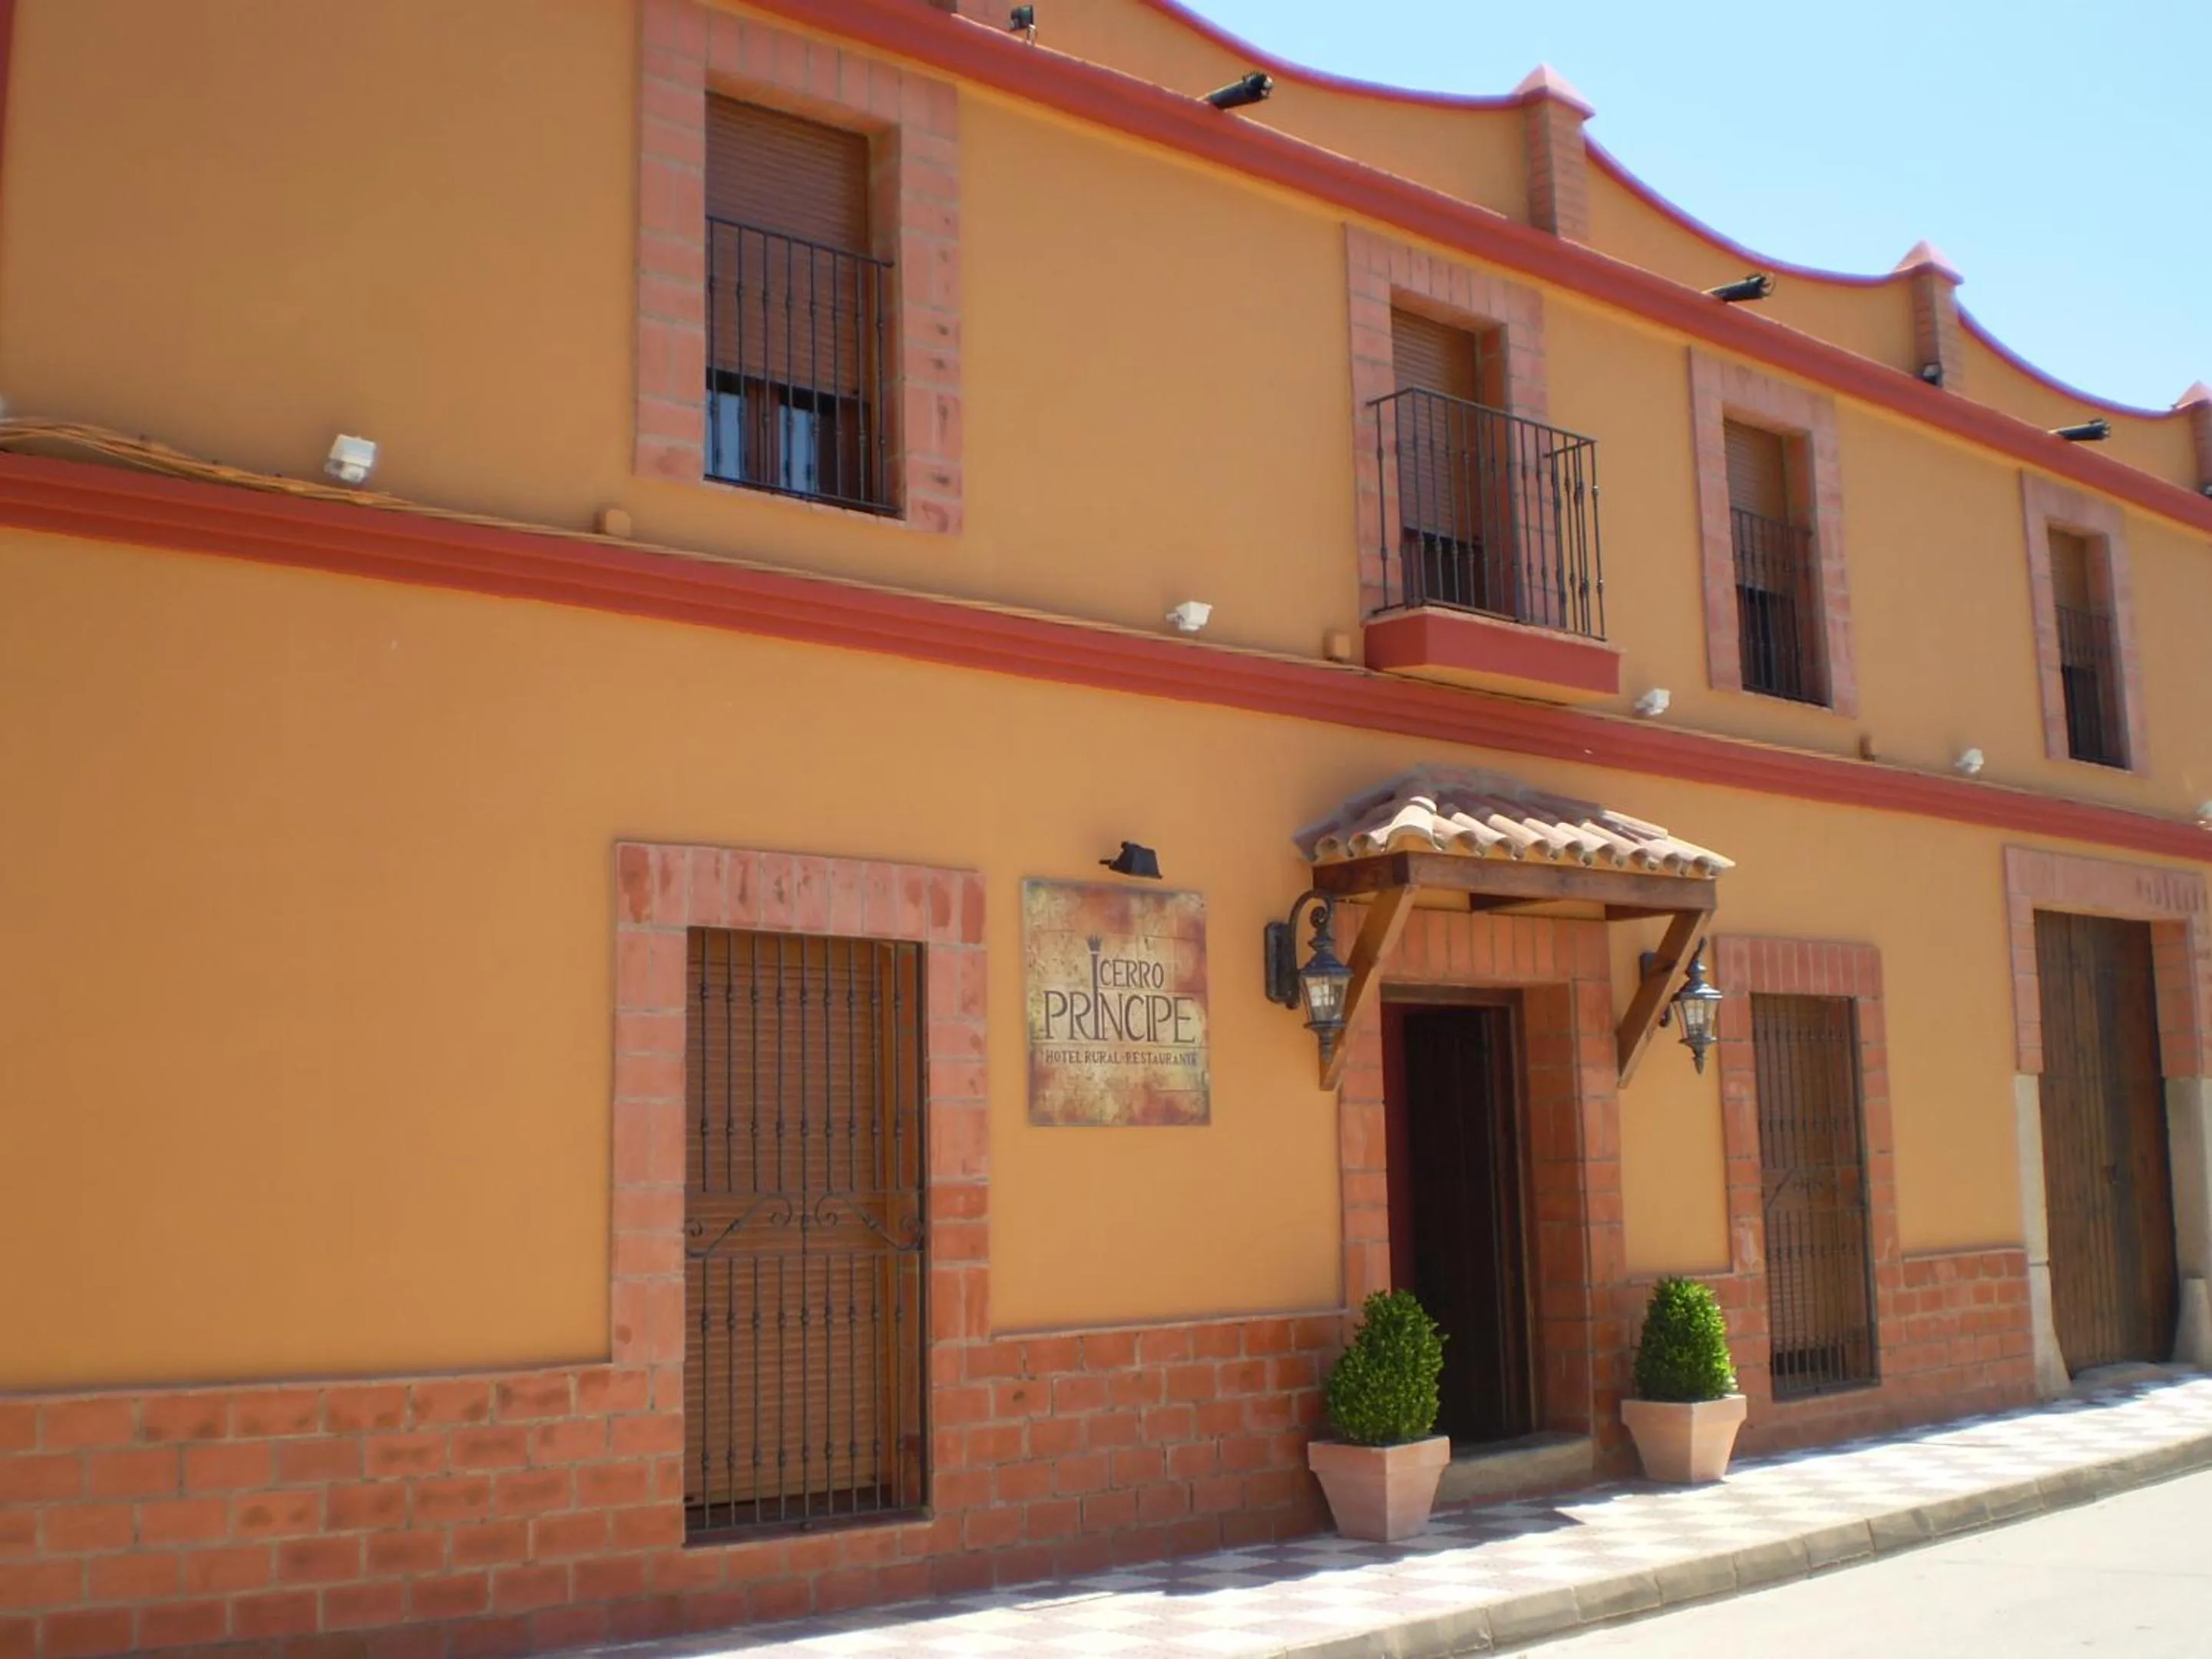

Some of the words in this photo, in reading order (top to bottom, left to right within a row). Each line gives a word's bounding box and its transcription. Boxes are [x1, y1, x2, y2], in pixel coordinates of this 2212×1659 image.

[1099, 959, 1164, 989] CERRO
[1043, 953, 1195, 1043] PRINCIPE
[1045, 1049, 1082, 1064] HOTEL
[1084, 1050, 1121, 1064] RURAL
[1126, 1051, 1197, 1067] RESTAURANTE
